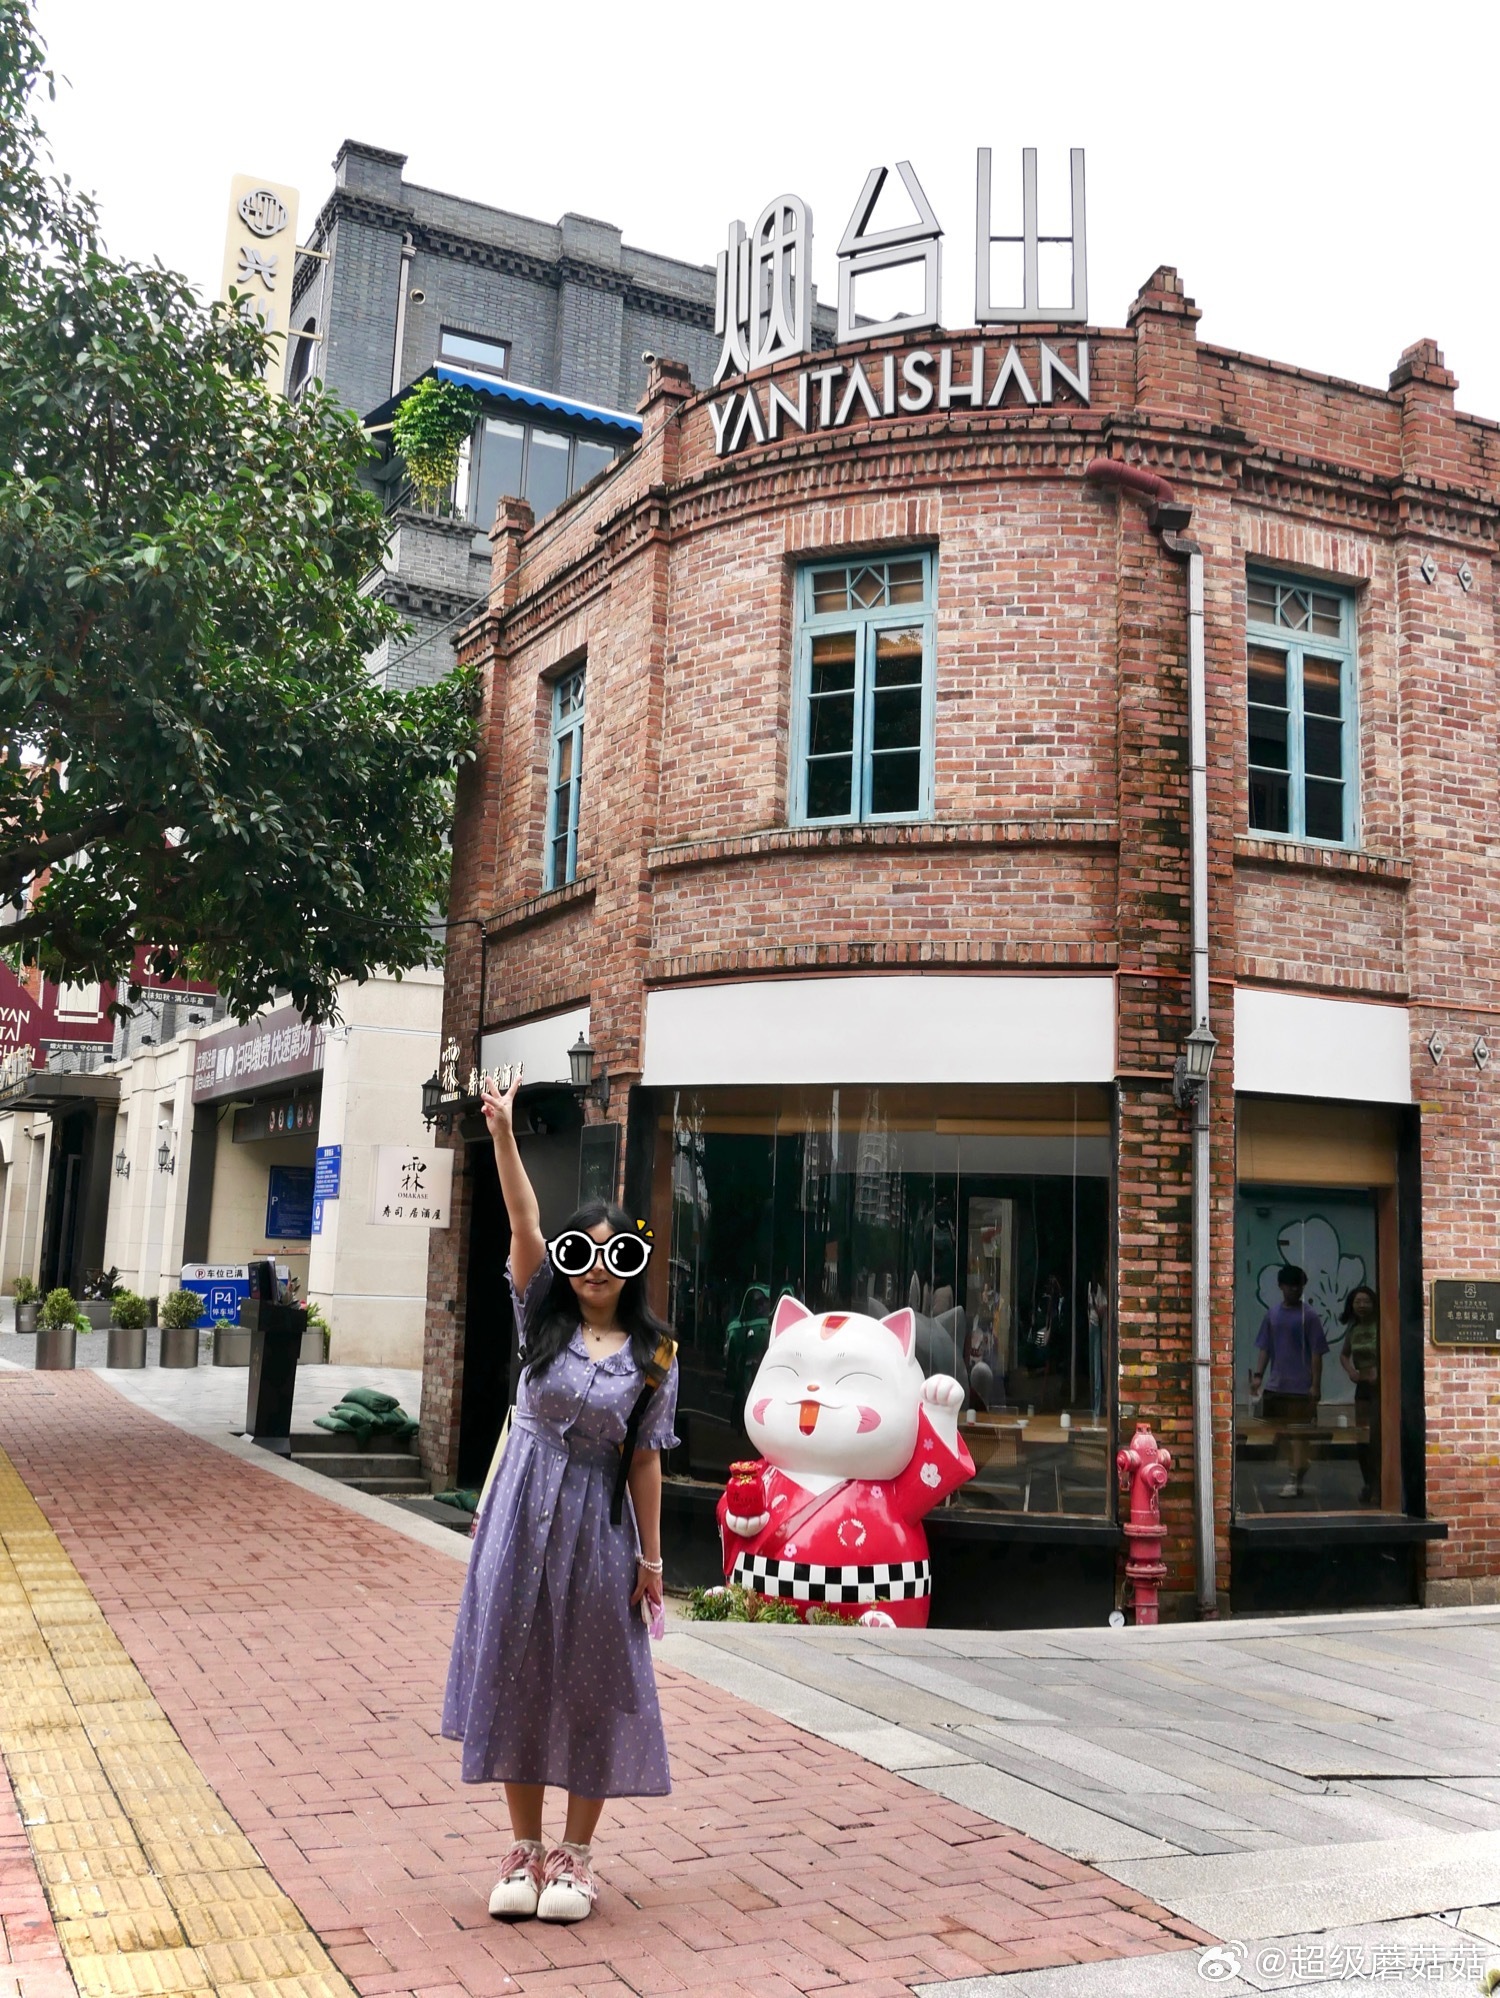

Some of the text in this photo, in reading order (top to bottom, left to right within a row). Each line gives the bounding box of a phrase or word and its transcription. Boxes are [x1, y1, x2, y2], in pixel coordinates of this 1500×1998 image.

[708, 339, 1091, 457] YANTAISHAN
[0, 1006, 30, 1024] YAN
[235, 1033, 272, 1077] 扫码缴费
[271, 1023, 312, 1067] 快速离场
[195, 1048, 217, 1073] 立即注册
[397, 1192, 429, 1200] OMAKASE
[206, 1269, 243, 1278] 车位已满
[214, 1291, 232, 1305] P4
[212, 1307, 234, 1317] 停车场
